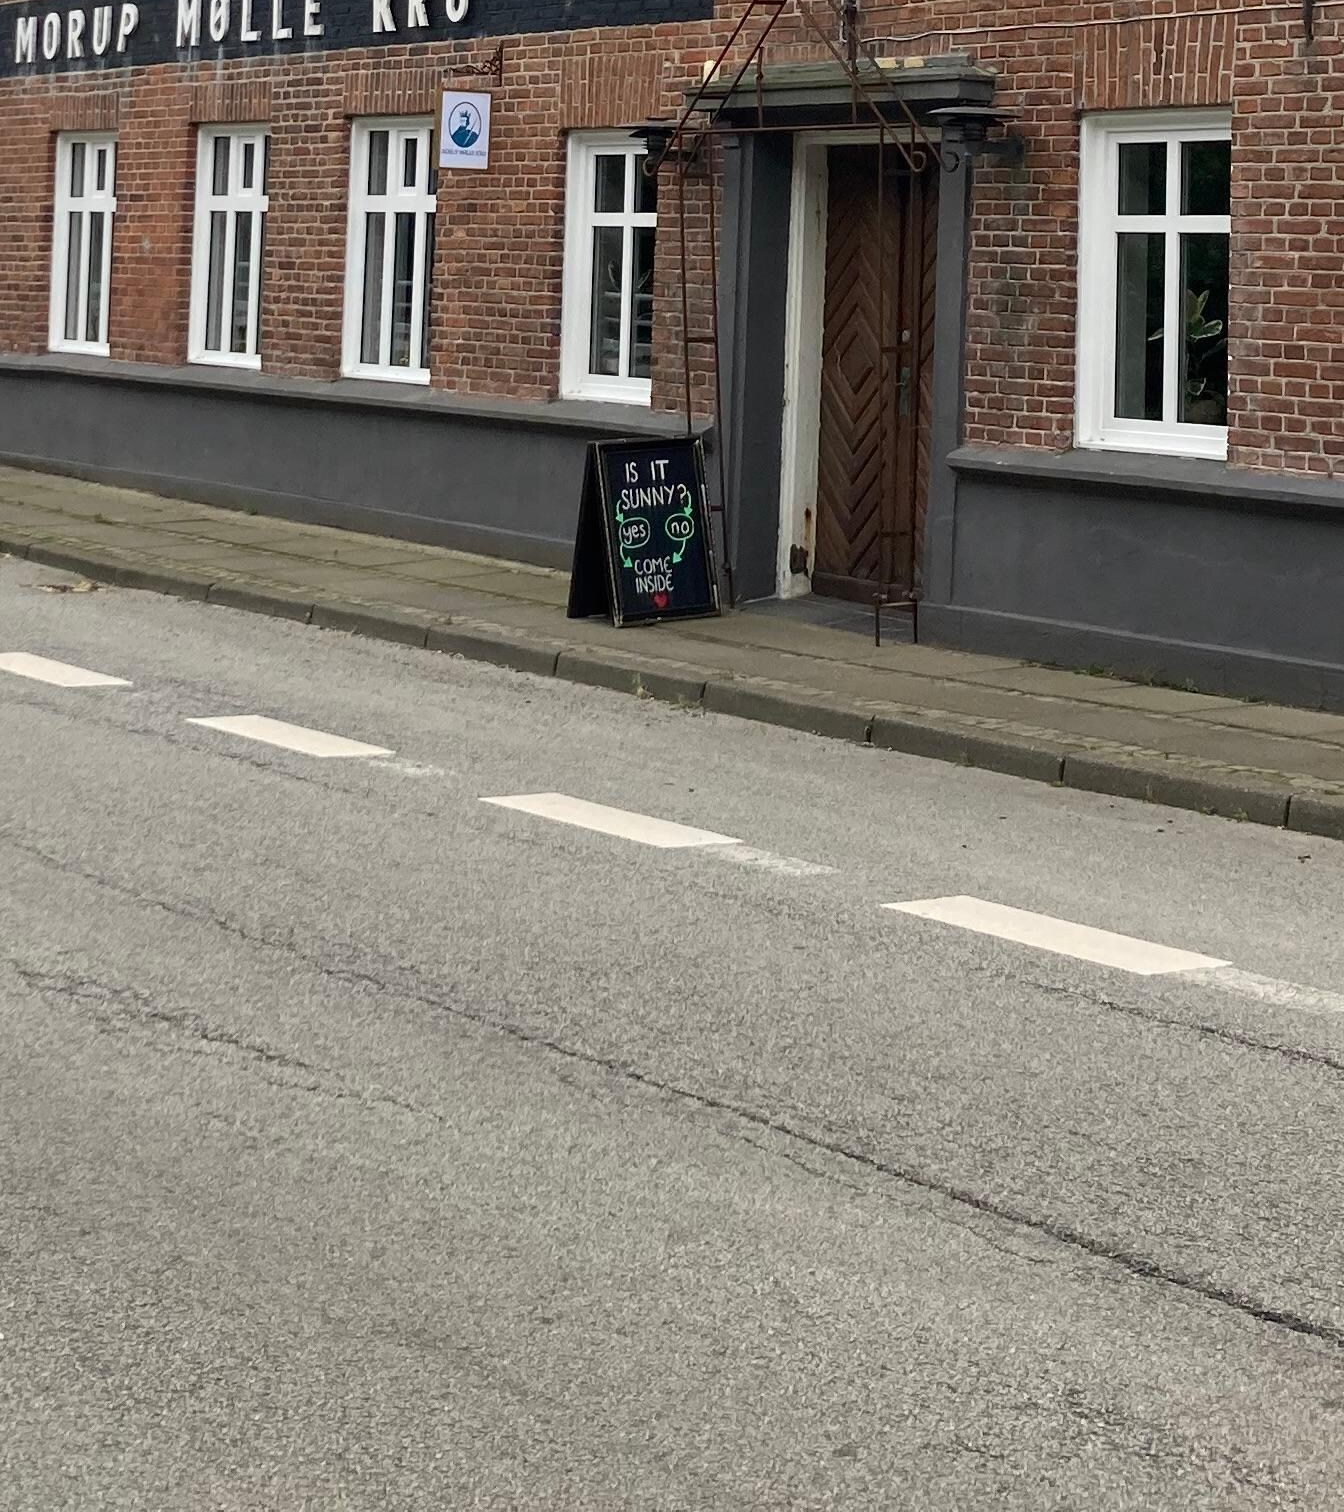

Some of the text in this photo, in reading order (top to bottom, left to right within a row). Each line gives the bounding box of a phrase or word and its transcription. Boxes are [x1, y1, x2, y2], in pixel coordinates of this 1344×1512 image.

[14, 0, 139, 65] MORUP
[625, 459, 669, 483] IS IT
[621, 483, 687, 510] SUNNY?
[622, 524, 646, 545] yes
[670, 521, 690, 535] no
[634, 556, 673, 575] COME
[635, 573, 675, 594] INSIDE
